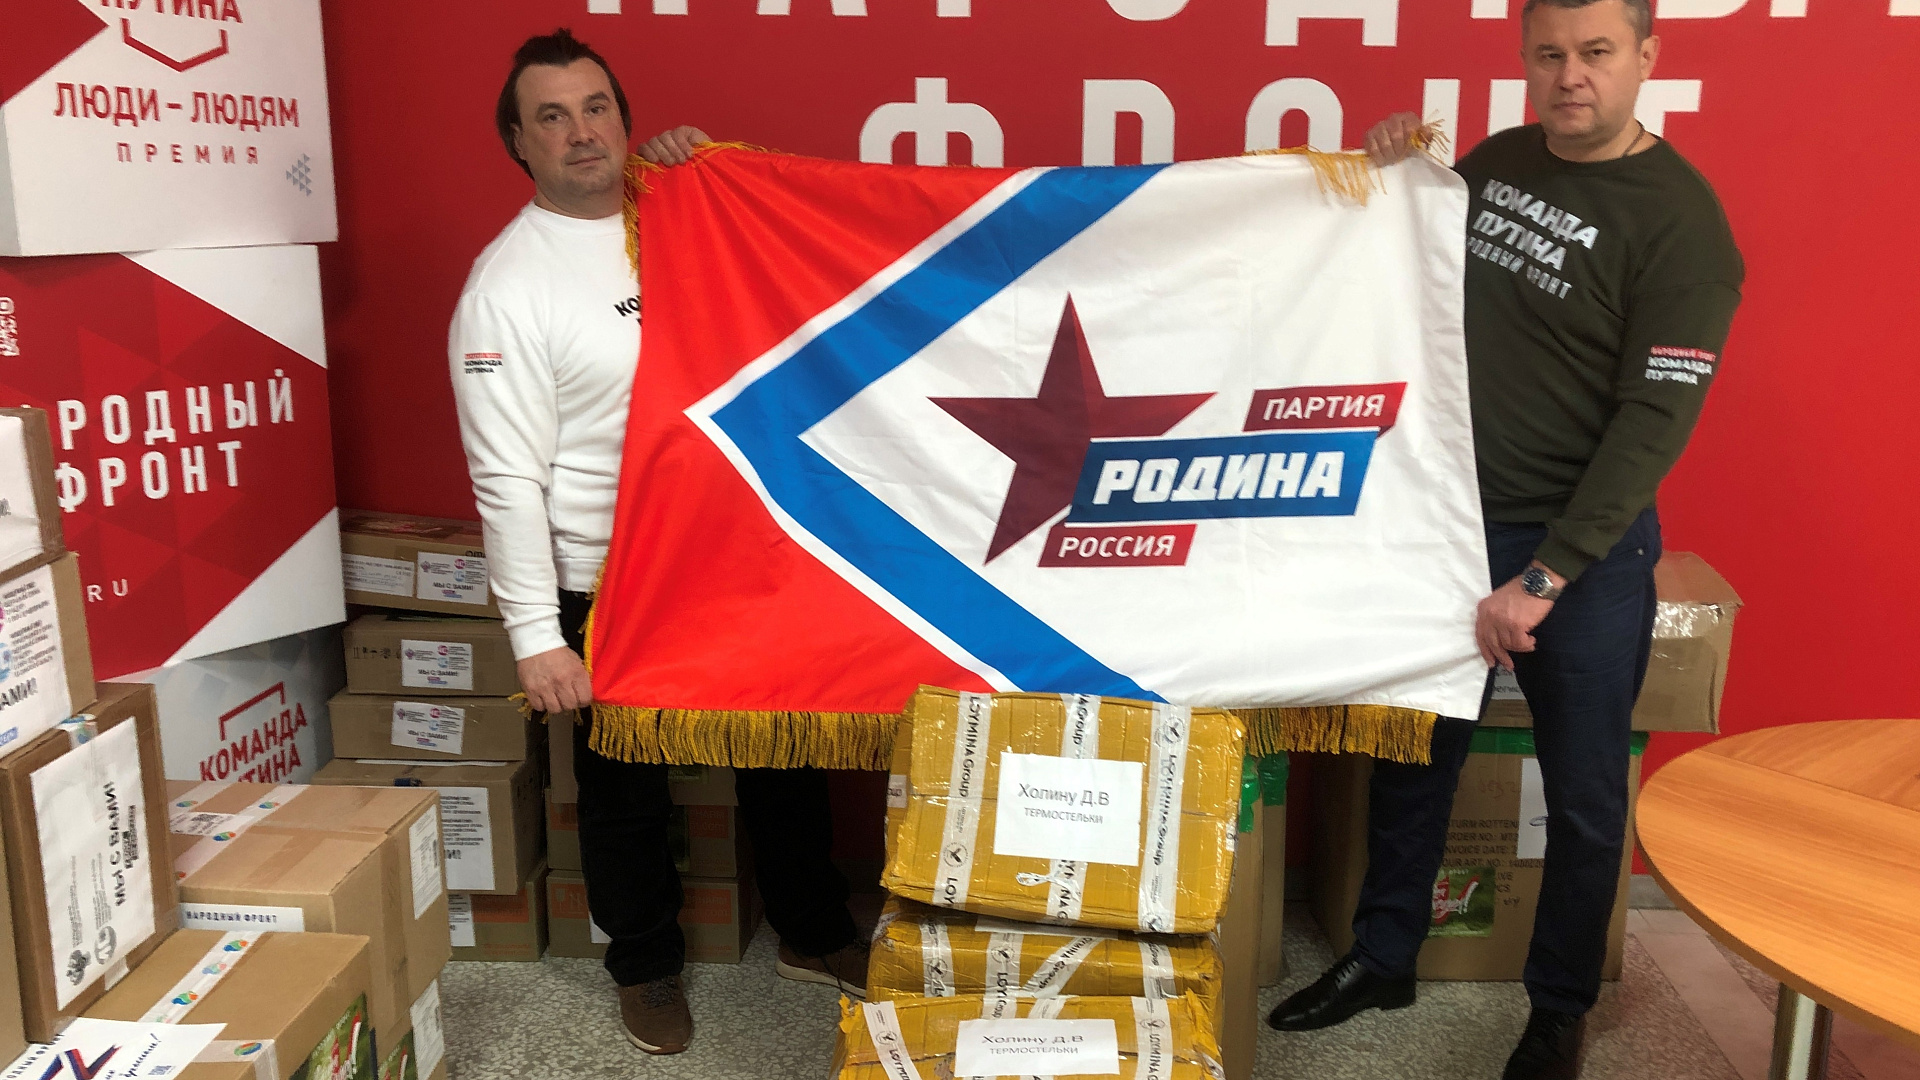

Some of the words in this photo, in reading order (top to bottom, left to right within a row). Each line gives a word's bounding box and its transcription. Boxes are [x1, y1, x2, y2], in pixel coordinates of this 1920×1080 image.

[54, 82, 161, 128] ЛЮДИ
[191, 92, 301, 132] ЛЮДЯМ
[117, 142, 259, 165] ПРЕМИЯ
[1480, 178, 1600, 250] КОМАНДА
[57, 368, 295, 450] РОДНЫЙ
[1263, 394, 1386, 421] ПАРТИЯ
[54, 440, 243, 513] ФРОНТ
[1092, 450, 1346, 505] РОДИНА
[1058, 534, 1177, 559] РОССИЯ
[200, 702, 308, 781] КОМАНДА
[966, 696, 982, 757] LOYMINA
[958, 758, 977, 798] Group
[1018, 783, 1078, 806] Холину
[1080, 789, 1110, 807] Д.В
[1024, 807, 1104, 824] ТЕРМОСТЕЛЬКИ
[982, 1034, 1048, 1046] Холину
[989, 1046, 1079, 1056] ТЕРМОСТЕЛЬКИ
